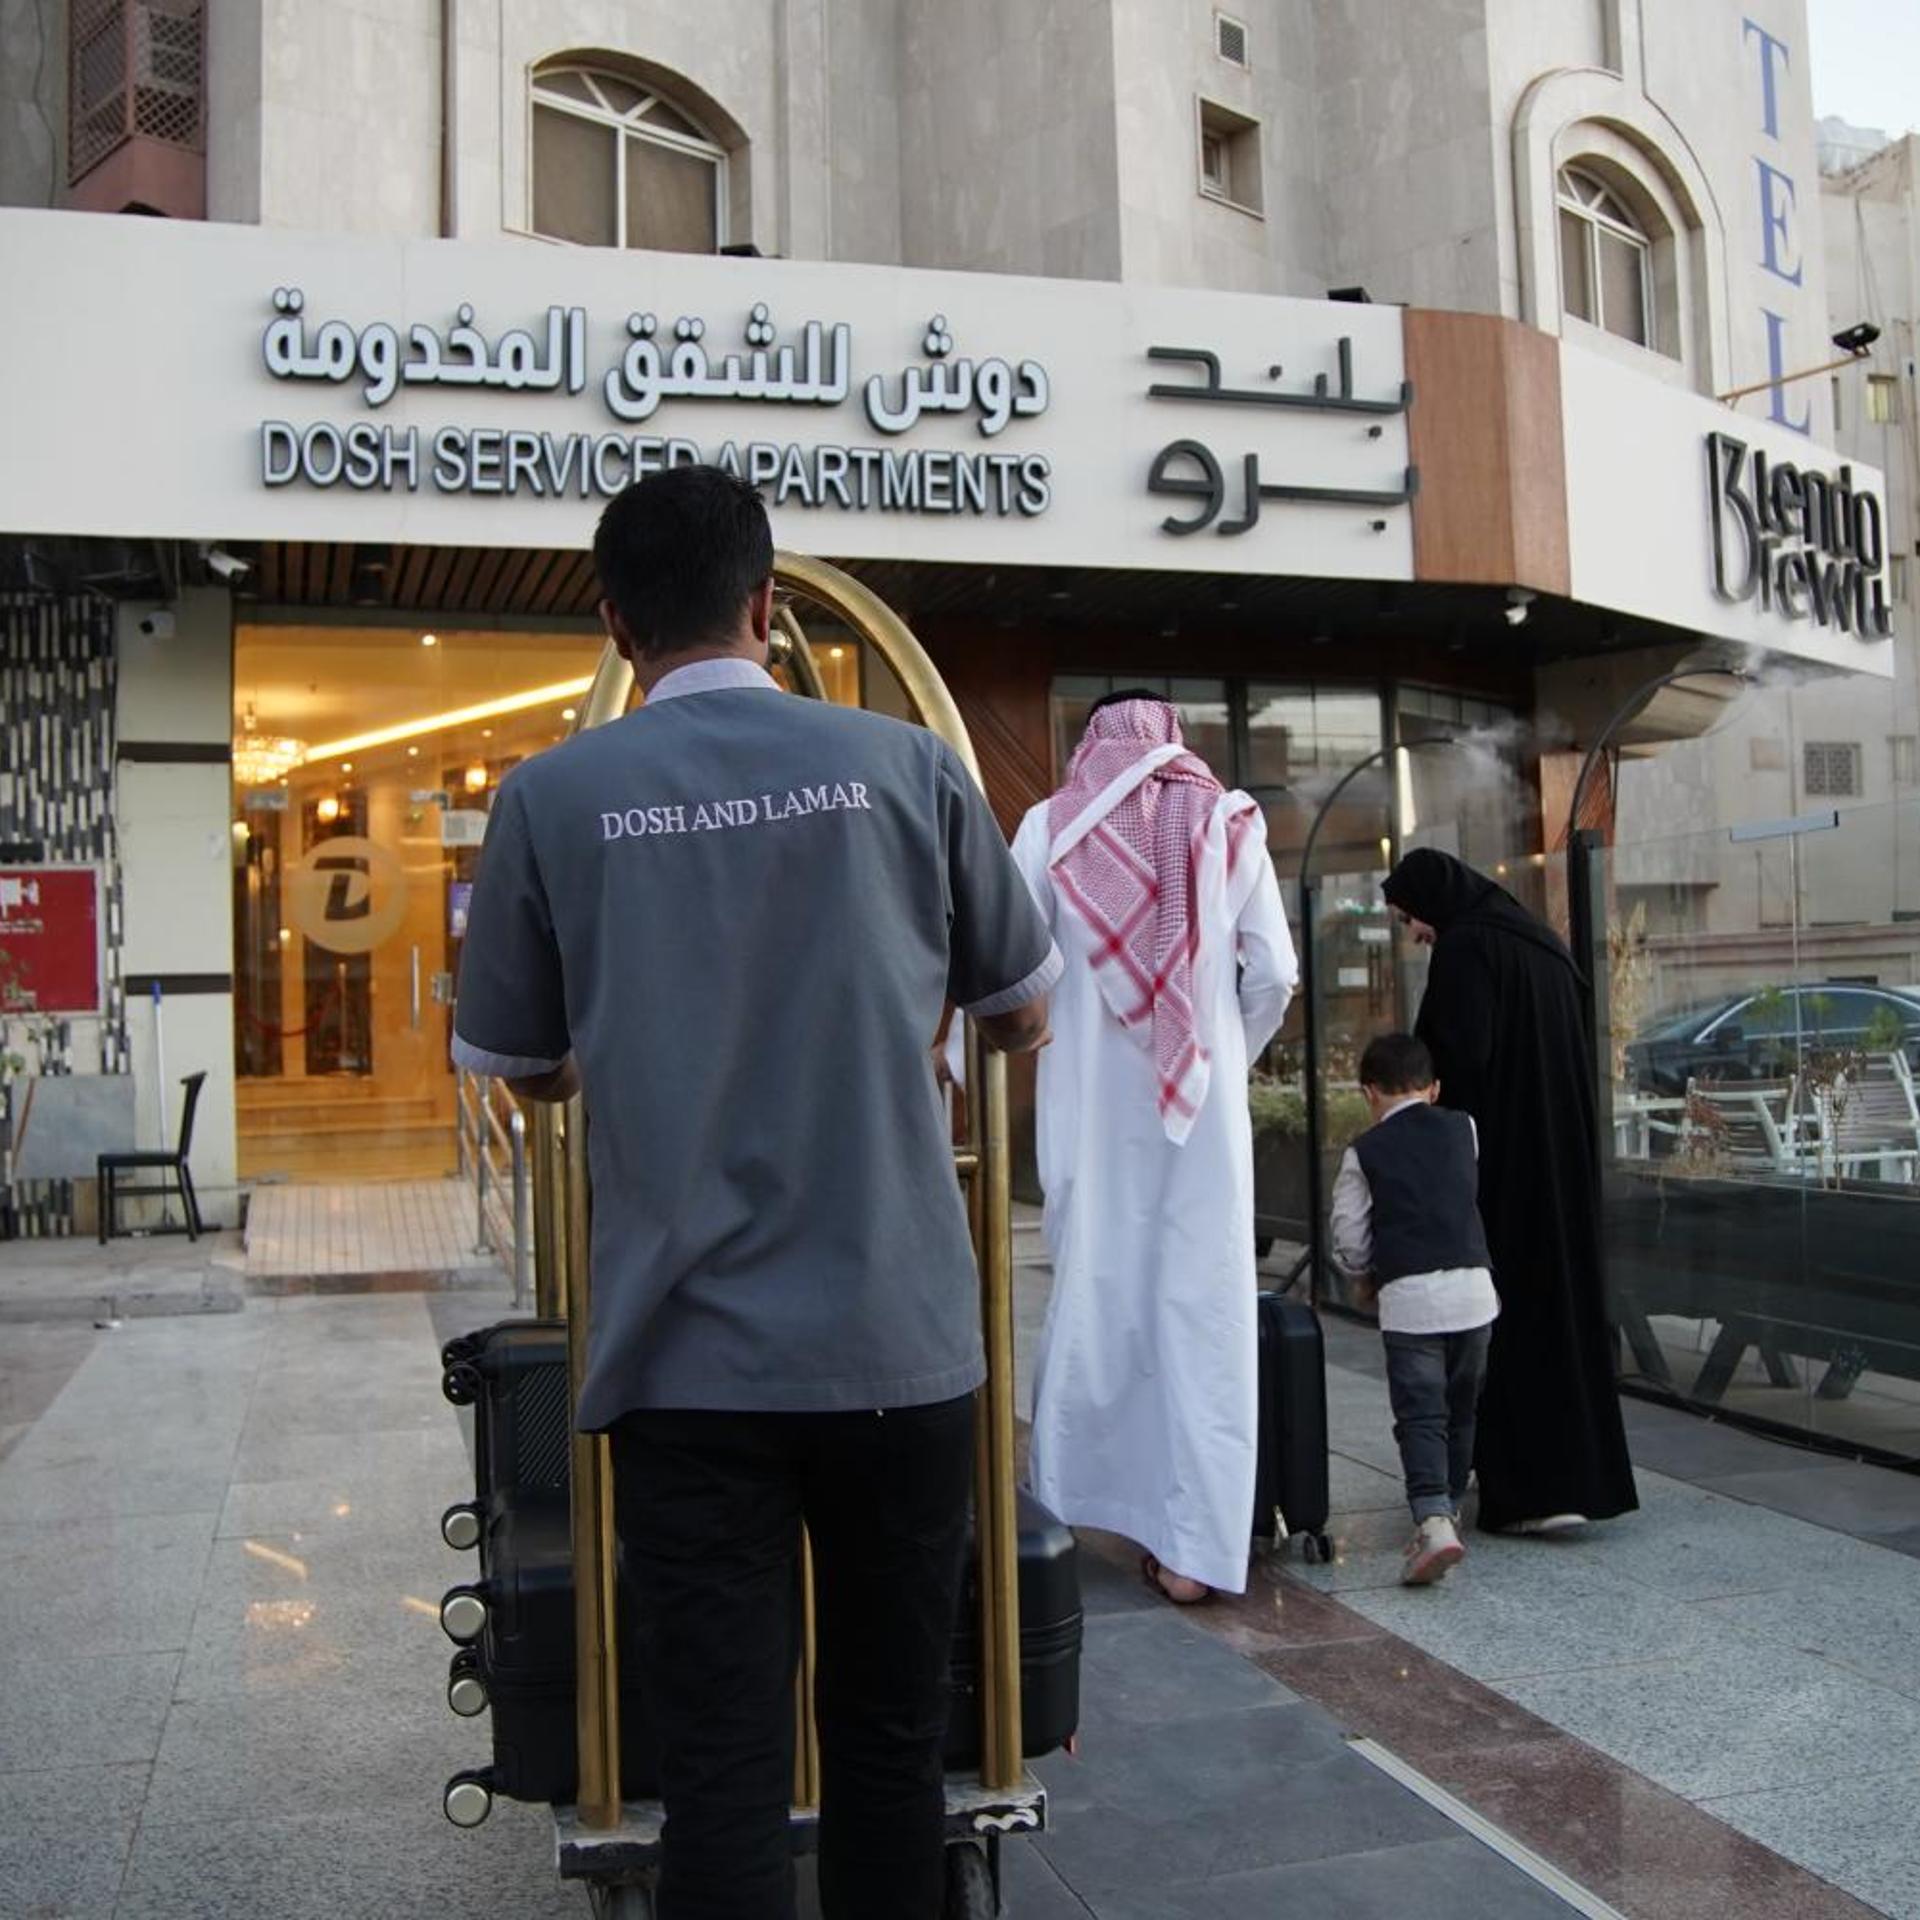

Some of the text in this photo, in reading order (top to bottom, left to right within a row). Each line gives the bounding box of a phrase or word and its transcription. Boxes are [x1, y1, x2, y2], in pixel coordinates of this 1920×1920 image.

[262, 287, 1049, 435] دوش للشقق المخدومة
[262, 420, 418, 491] DOSH
[601, 782, 872, 840] DOSH AND LAMAR
